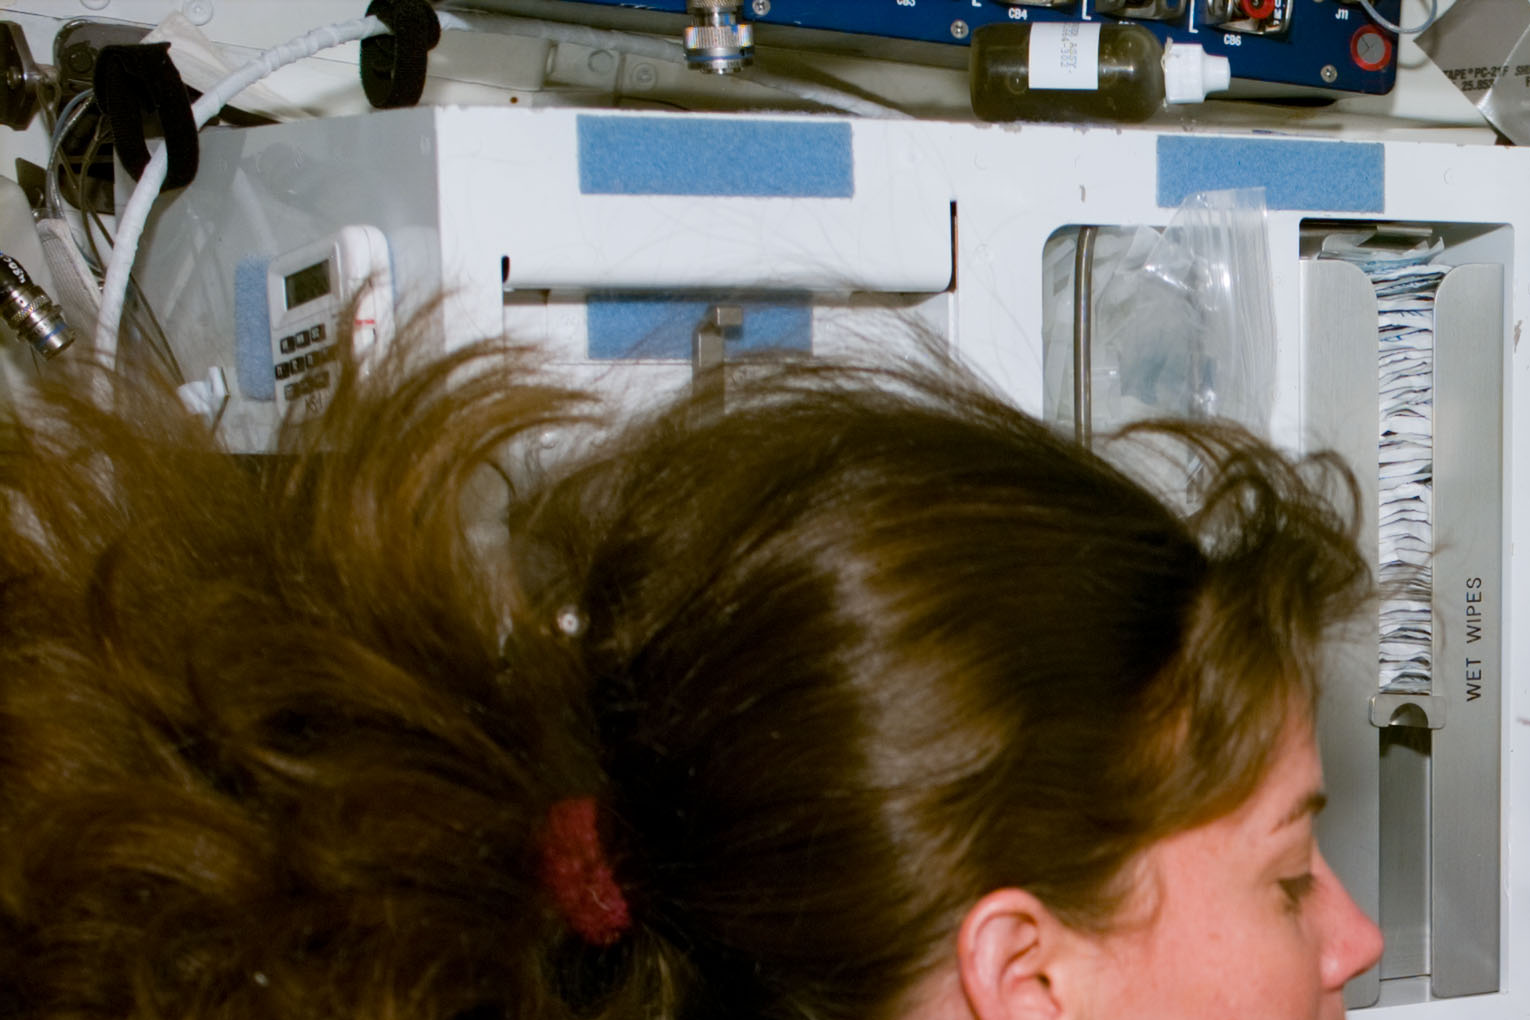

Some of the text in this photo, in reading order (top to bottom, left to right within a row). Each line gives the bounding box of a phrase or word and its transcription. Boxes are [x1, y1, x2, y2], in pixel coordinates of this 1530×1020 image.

[1008, 7, 1028, 20] CB4
[1223, 34, 1242, 46] CB6
[1466, 577, 1482, 702] WET WIPES
